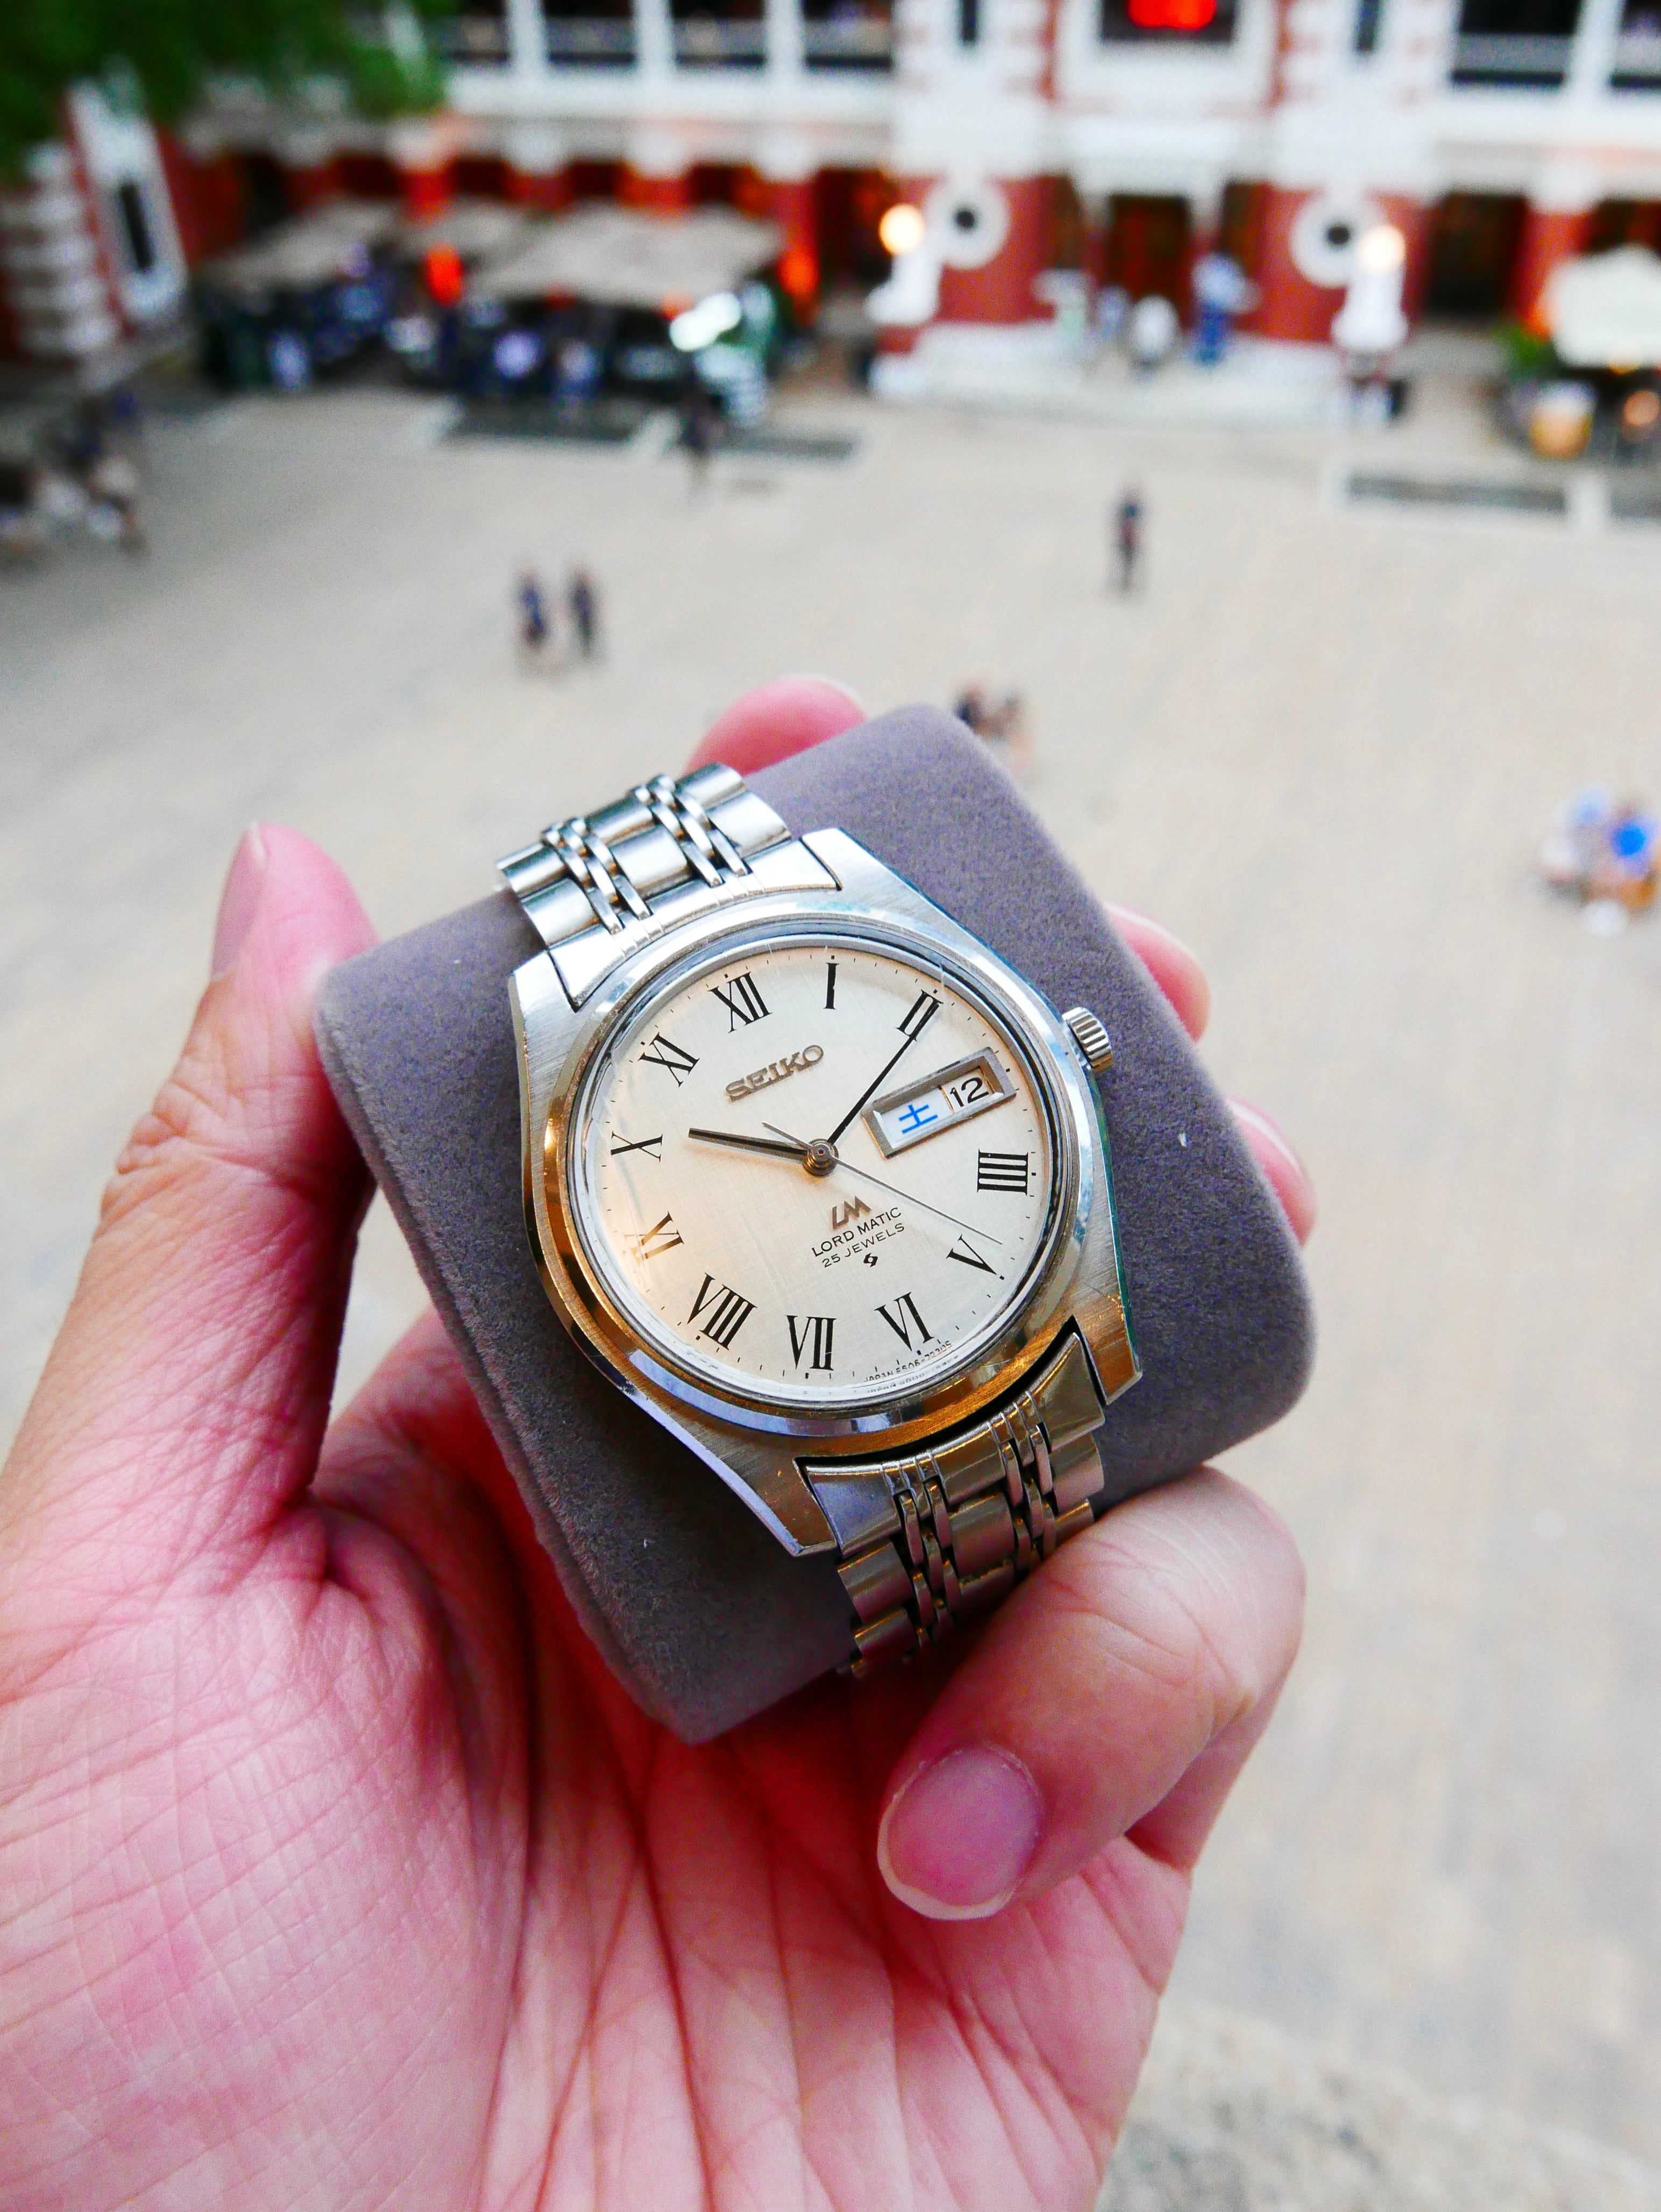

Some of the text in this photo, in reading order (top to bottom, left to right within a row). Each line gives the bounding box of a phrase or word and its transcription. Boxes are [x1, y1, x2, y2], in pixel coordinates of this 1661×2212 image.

[708, 972, 772, 1033] XII
[823, 962, 839, 1010] I
[896, 989, 943, 1041] II
[638, 1032, 700, 1087] XI
[725, 1045, 824, 1102] SEIKO
[899, 1077, 989, 1134] 土 12
[611, 1130, 663, 1162] X
[977, 1148, 1028, 1196] IIII
[811, 1207, 902, 1257] LORD MATIC
[822, 1223, 905, 1268] 25 JEWELS
[946, 1234, 997, 1275] V
[686, 1273, 757, 1350] VIII
[874, 1292, 934, 1351] VI
[785, 1315, 836, 1371] VII
